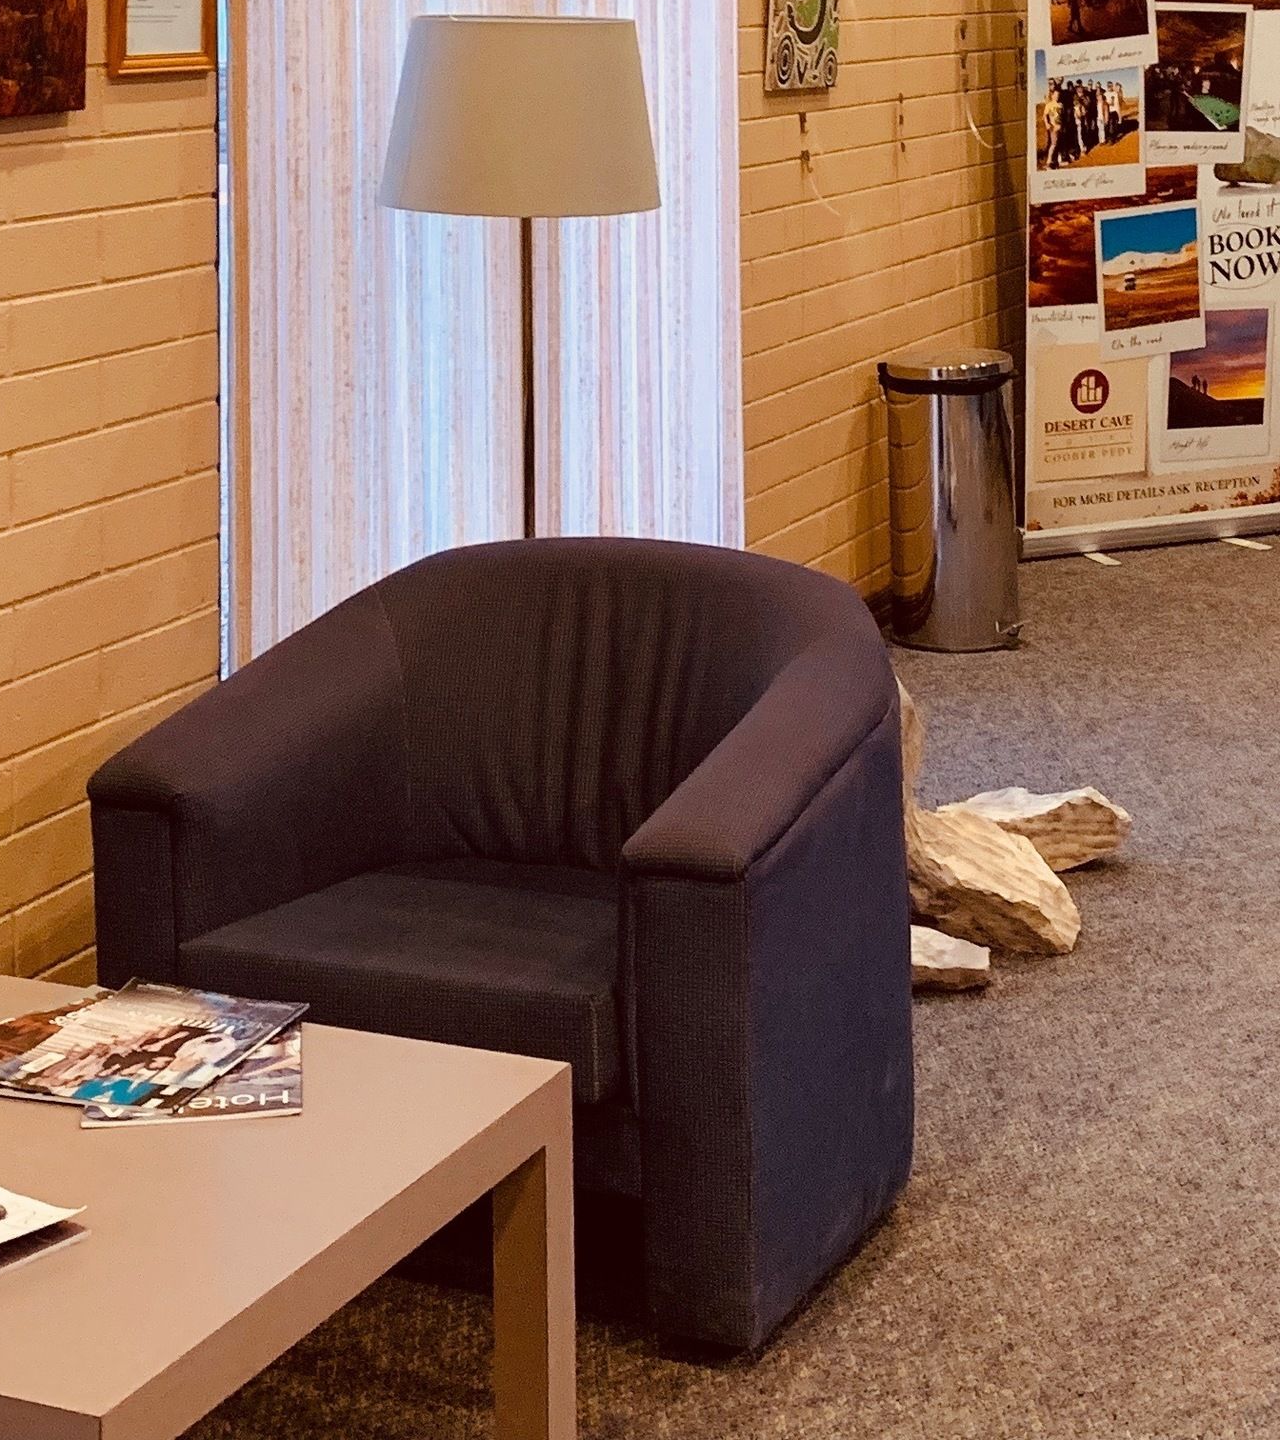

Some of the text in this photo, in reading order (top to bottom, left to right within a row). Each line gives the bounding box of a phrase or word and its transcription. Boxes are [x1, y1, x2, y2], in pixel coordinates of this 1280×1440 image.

[1044, 414, 1133, 434] DESERT CAVE
[1044, 450, 1096, 463] COOBER
[1053, 475, 1261, 509] FOR MORE DETAILS ASK RECEPTION
